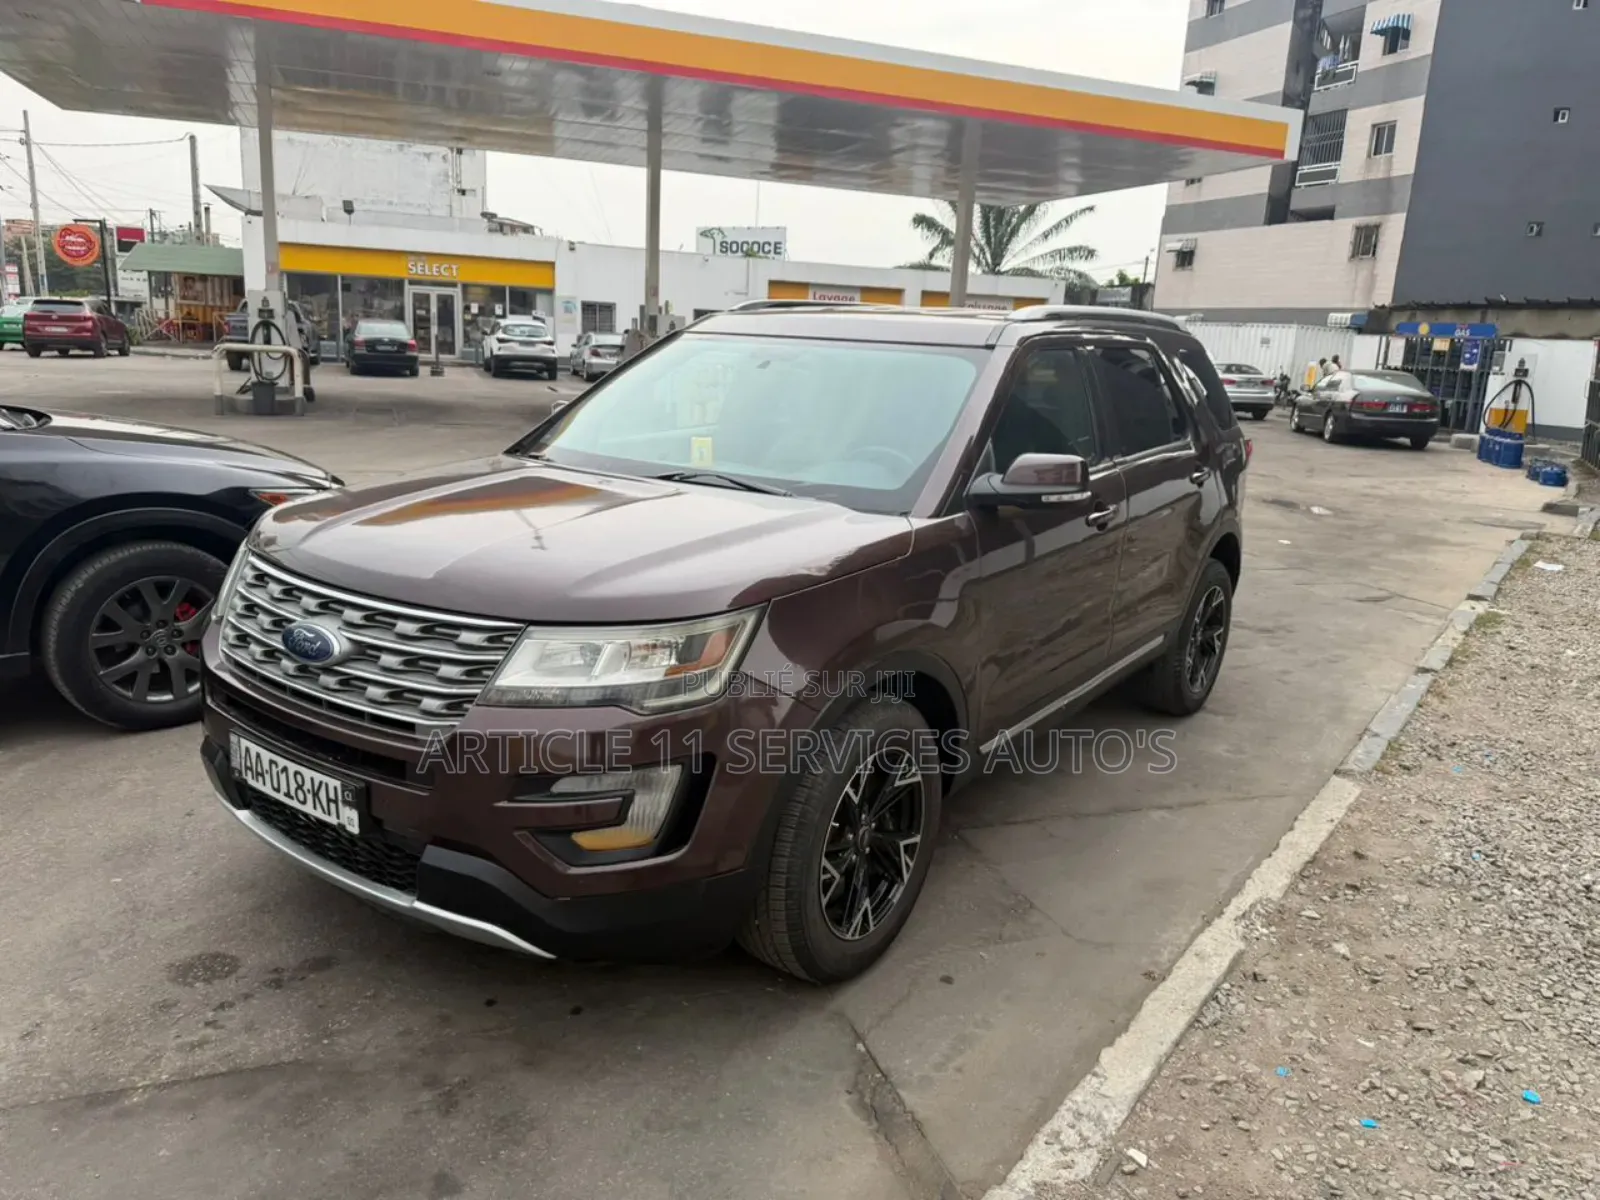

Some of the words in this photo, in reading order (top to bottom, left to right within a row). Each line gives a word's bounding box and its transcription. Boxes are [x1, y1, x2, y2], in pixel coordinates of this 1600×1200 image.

[719, 240, 782, 256] SOCOCE
[407, 261, 459, 277] SELECT
[288, 628, 321, 656] Ford
